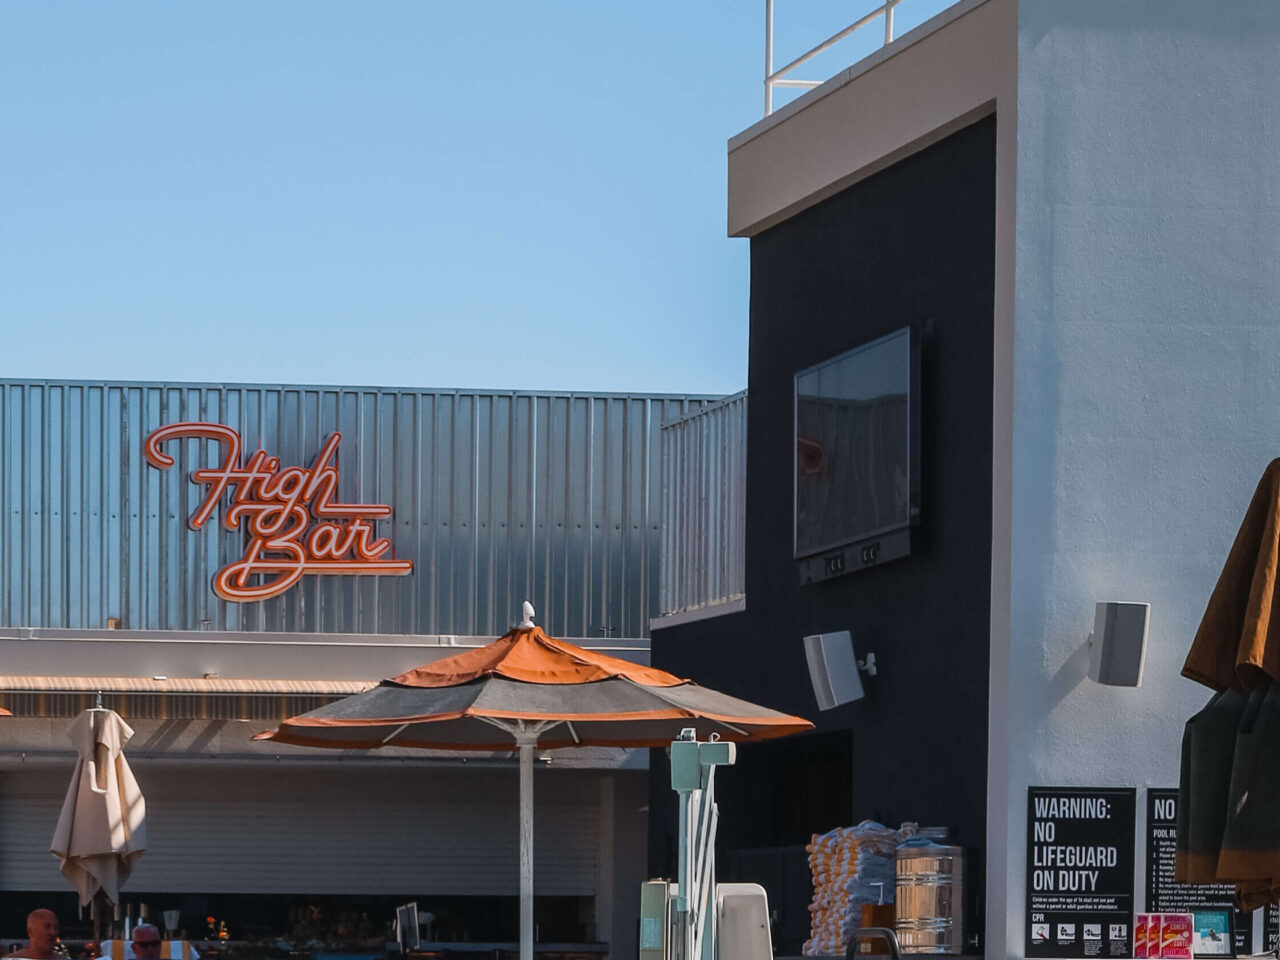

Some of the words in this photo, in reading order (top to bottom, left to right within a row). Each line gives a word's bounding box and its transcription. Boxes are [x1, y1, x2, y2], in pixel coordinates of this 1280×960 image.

[146, 422, 392, 536] High
[213, 502, 413, 602] Bar
[1034, 797, 1111, 819] WARNING:
[1154, 799, 1175, 819] NO
[1034, 821, 1055, 842] NO
[1153, 829, 1169, 838] POOL
[1034, 846, 1117, 867] LIFEGUARD
[1033, 870, 1054, 891] ON
[1059, 870, 1099, 891] DUTY
[1032, 913, 1044, 922] CPR
